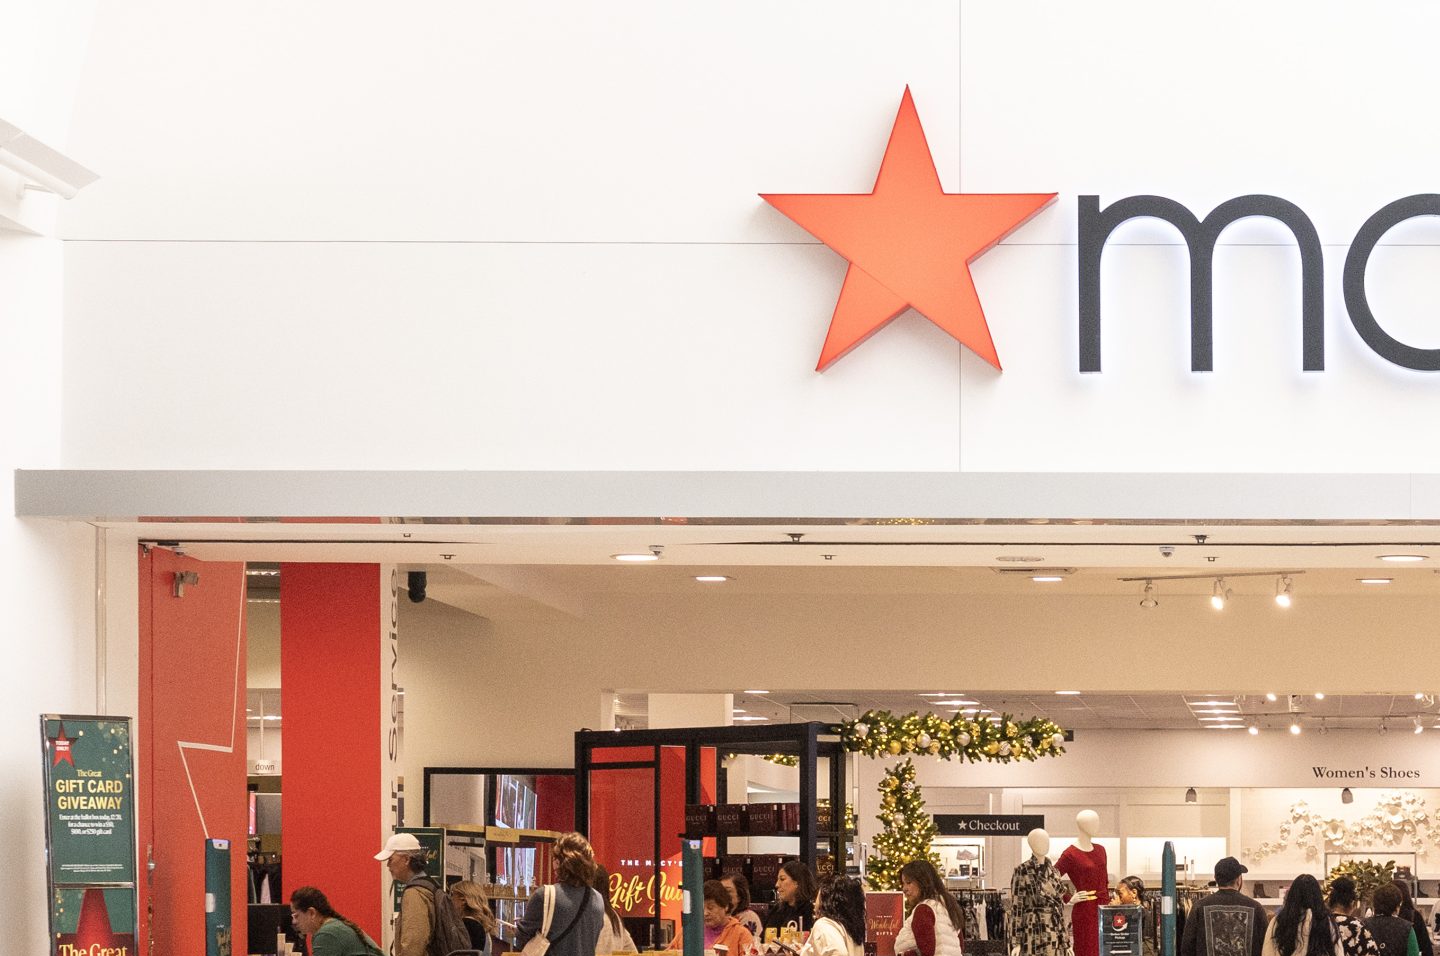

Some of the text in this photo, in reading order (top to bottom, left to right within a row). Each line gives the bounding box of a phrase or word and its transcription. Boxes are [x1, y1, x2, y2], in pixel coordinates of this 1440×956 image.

[388, 568, 398, 763] Service
[255, 762, 275, 771] down
[1312, 766, 1420, 778] Women's Shoes
[76, 769, 87, 777] The
[55, 779, 123, 793] GIFT CARD
[57, 796, 122, 810] GIVEAWAY
[968, 820, 1020, 831] Checkout
[645, 859, 683, 867] MCY'S
[608, 872, 646, 912] Gift
